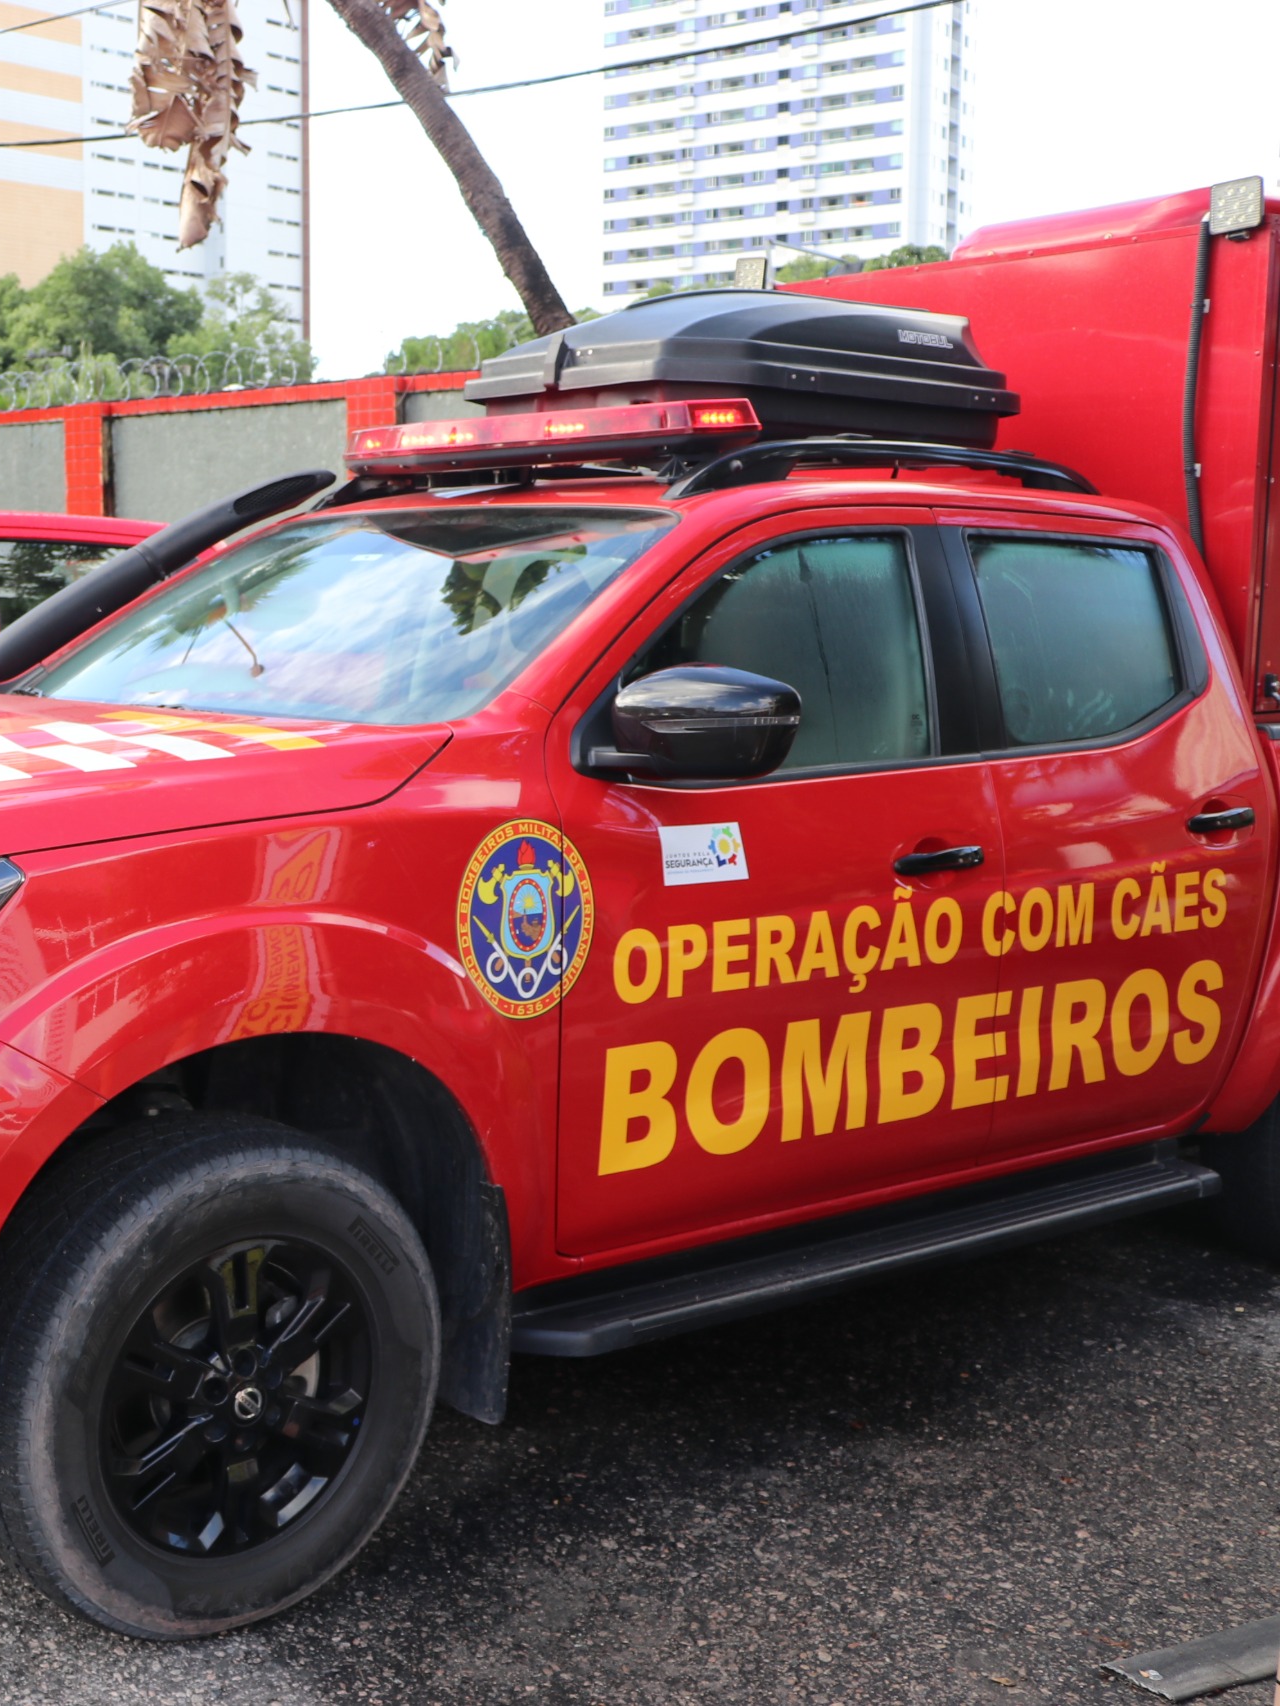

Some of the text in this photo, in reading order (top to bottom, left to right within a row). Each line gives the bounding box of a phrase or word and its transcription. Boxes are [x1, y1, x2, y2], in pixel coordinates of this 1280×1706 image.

[460, 823, 515, 912] BOMBEIROS
[569, 850, 584, 876] DE
[665, 858, 714, 869] SEGURANÇA
[458, 923, 470, 948] DE
[613, 862, 1228, 1005] OPERAÇÃO COM CÃES
[597, 959, 1224, 1177] BOMBEIROS
[347, 1215, 400, 1275] PIRELLI
[71, 1494, 116, 1568] PIRELLI
